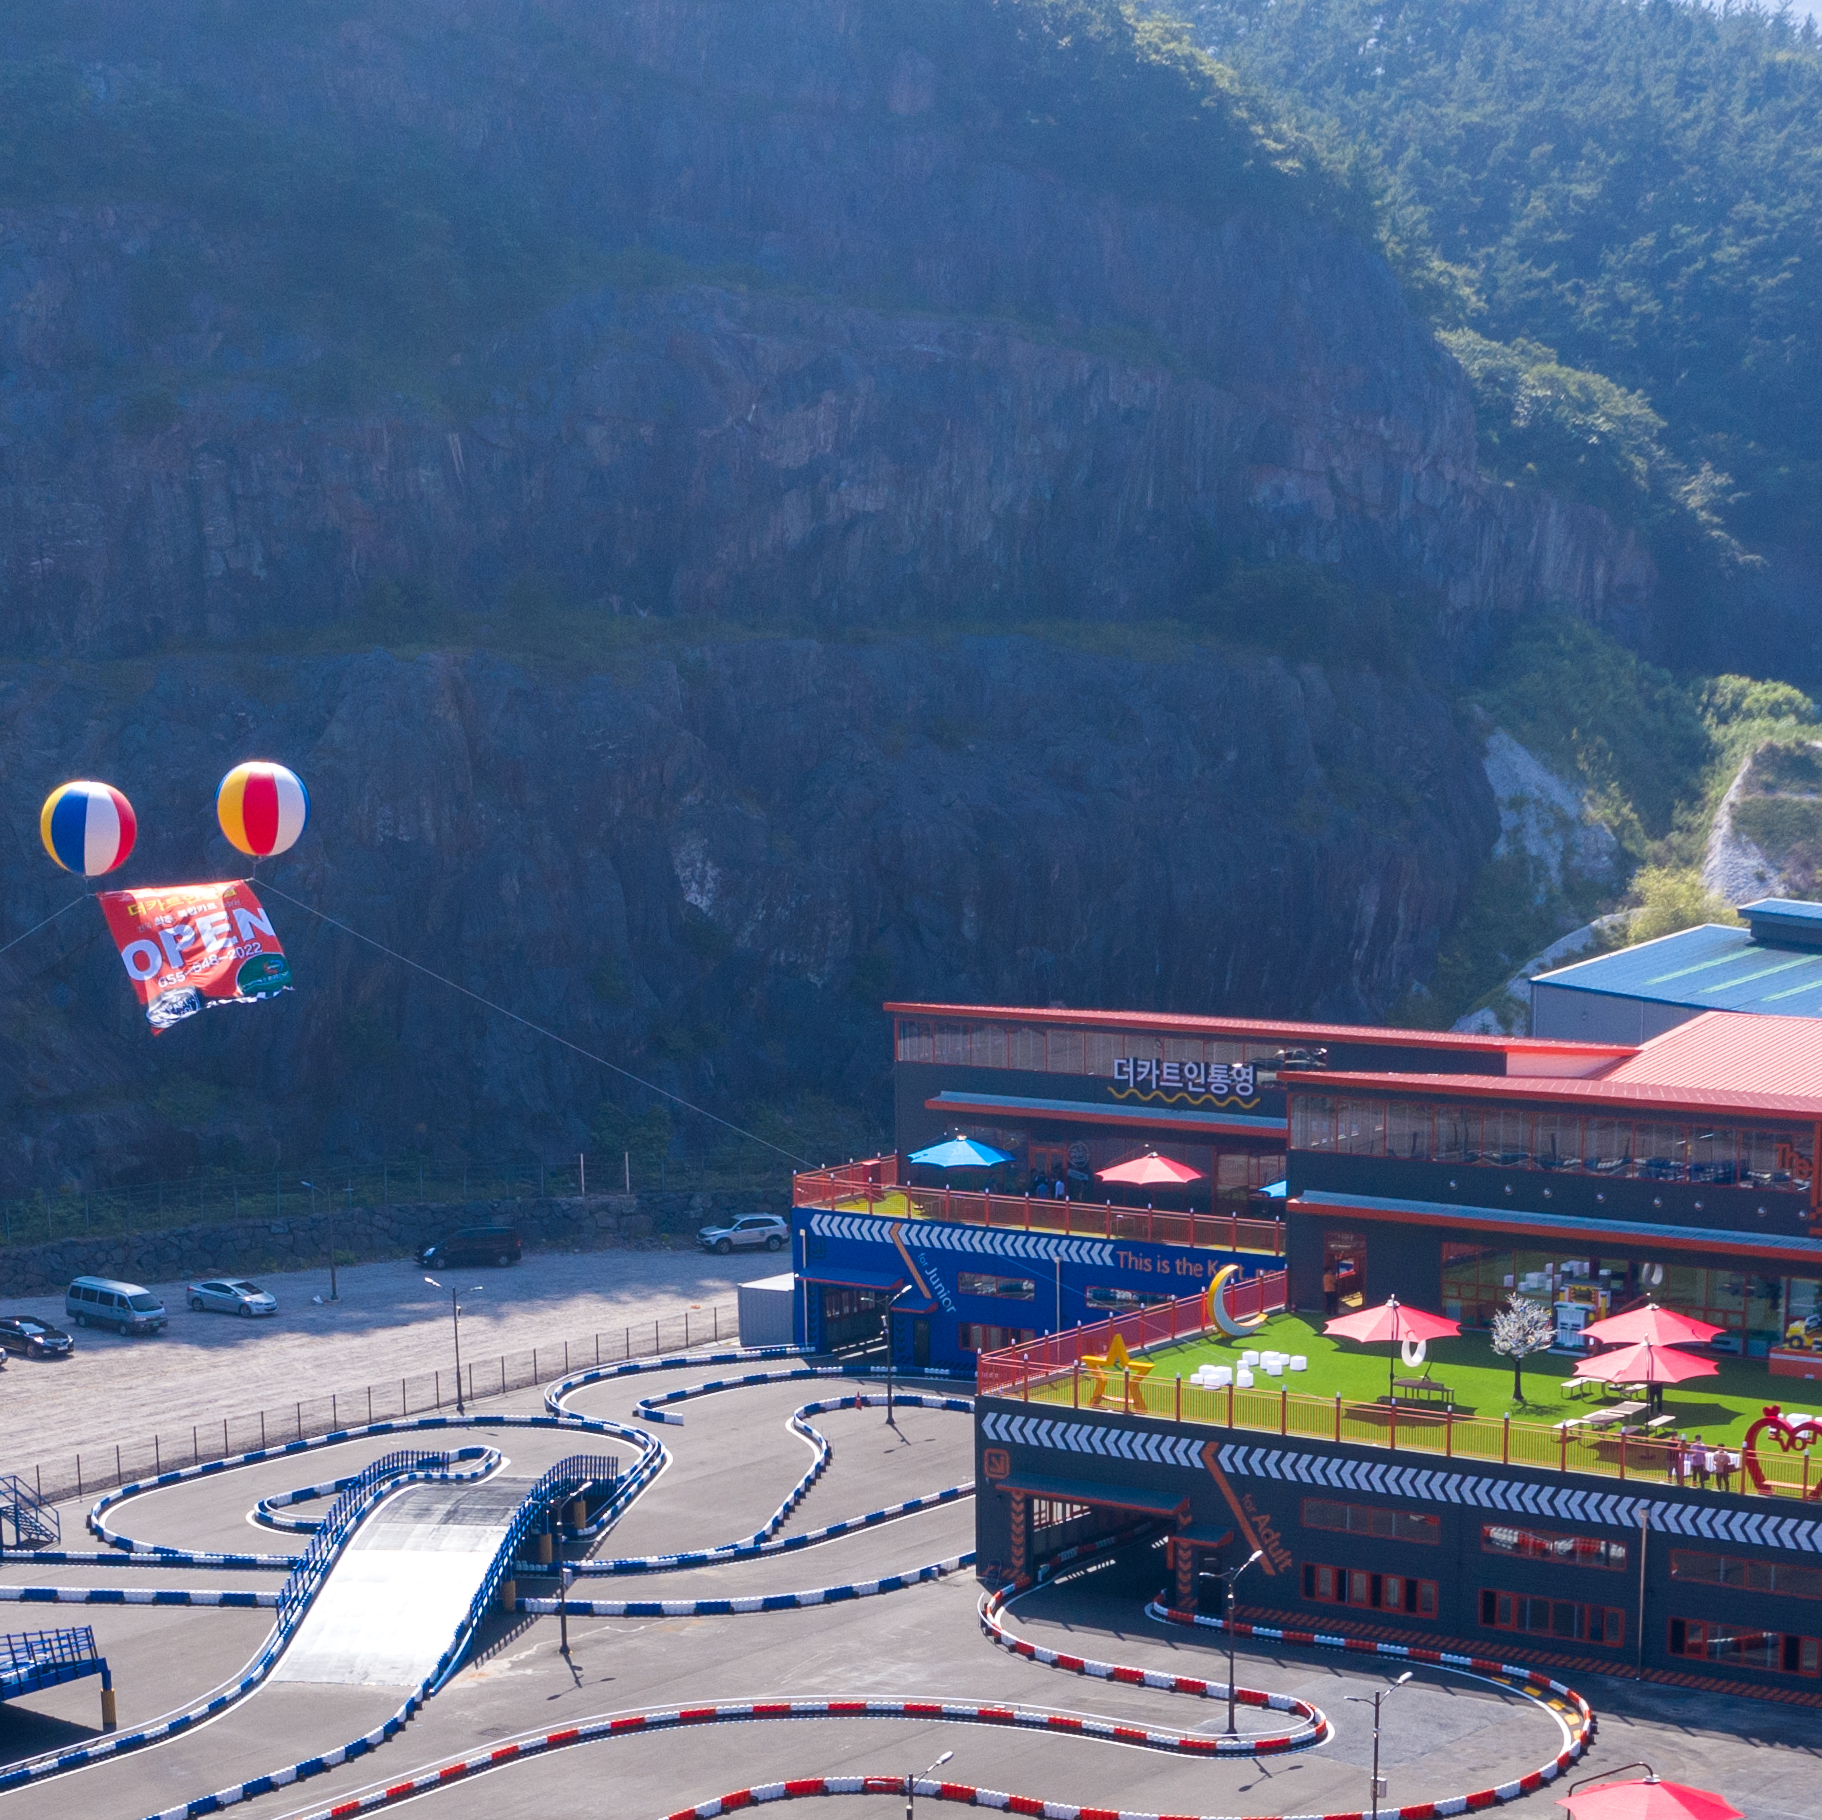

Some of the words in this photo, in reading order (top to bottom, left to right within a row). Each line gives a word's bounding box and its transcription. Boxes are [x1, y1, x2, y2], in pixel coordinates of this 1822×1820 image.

[121, 907, 276, 981] OPEN
[1113, 1057, 1254, 1096] 더카트인통영
[918, 1252, 929, 1267] for
[925, 1267, 957, 1312] Junior
[1116, 1250, 1153, 1272] This
[1157, 1254, 1171, 1275] is
[1175, 1256, 1204, 1277] the
[1252, 1514, 1293, 1573] Adult
